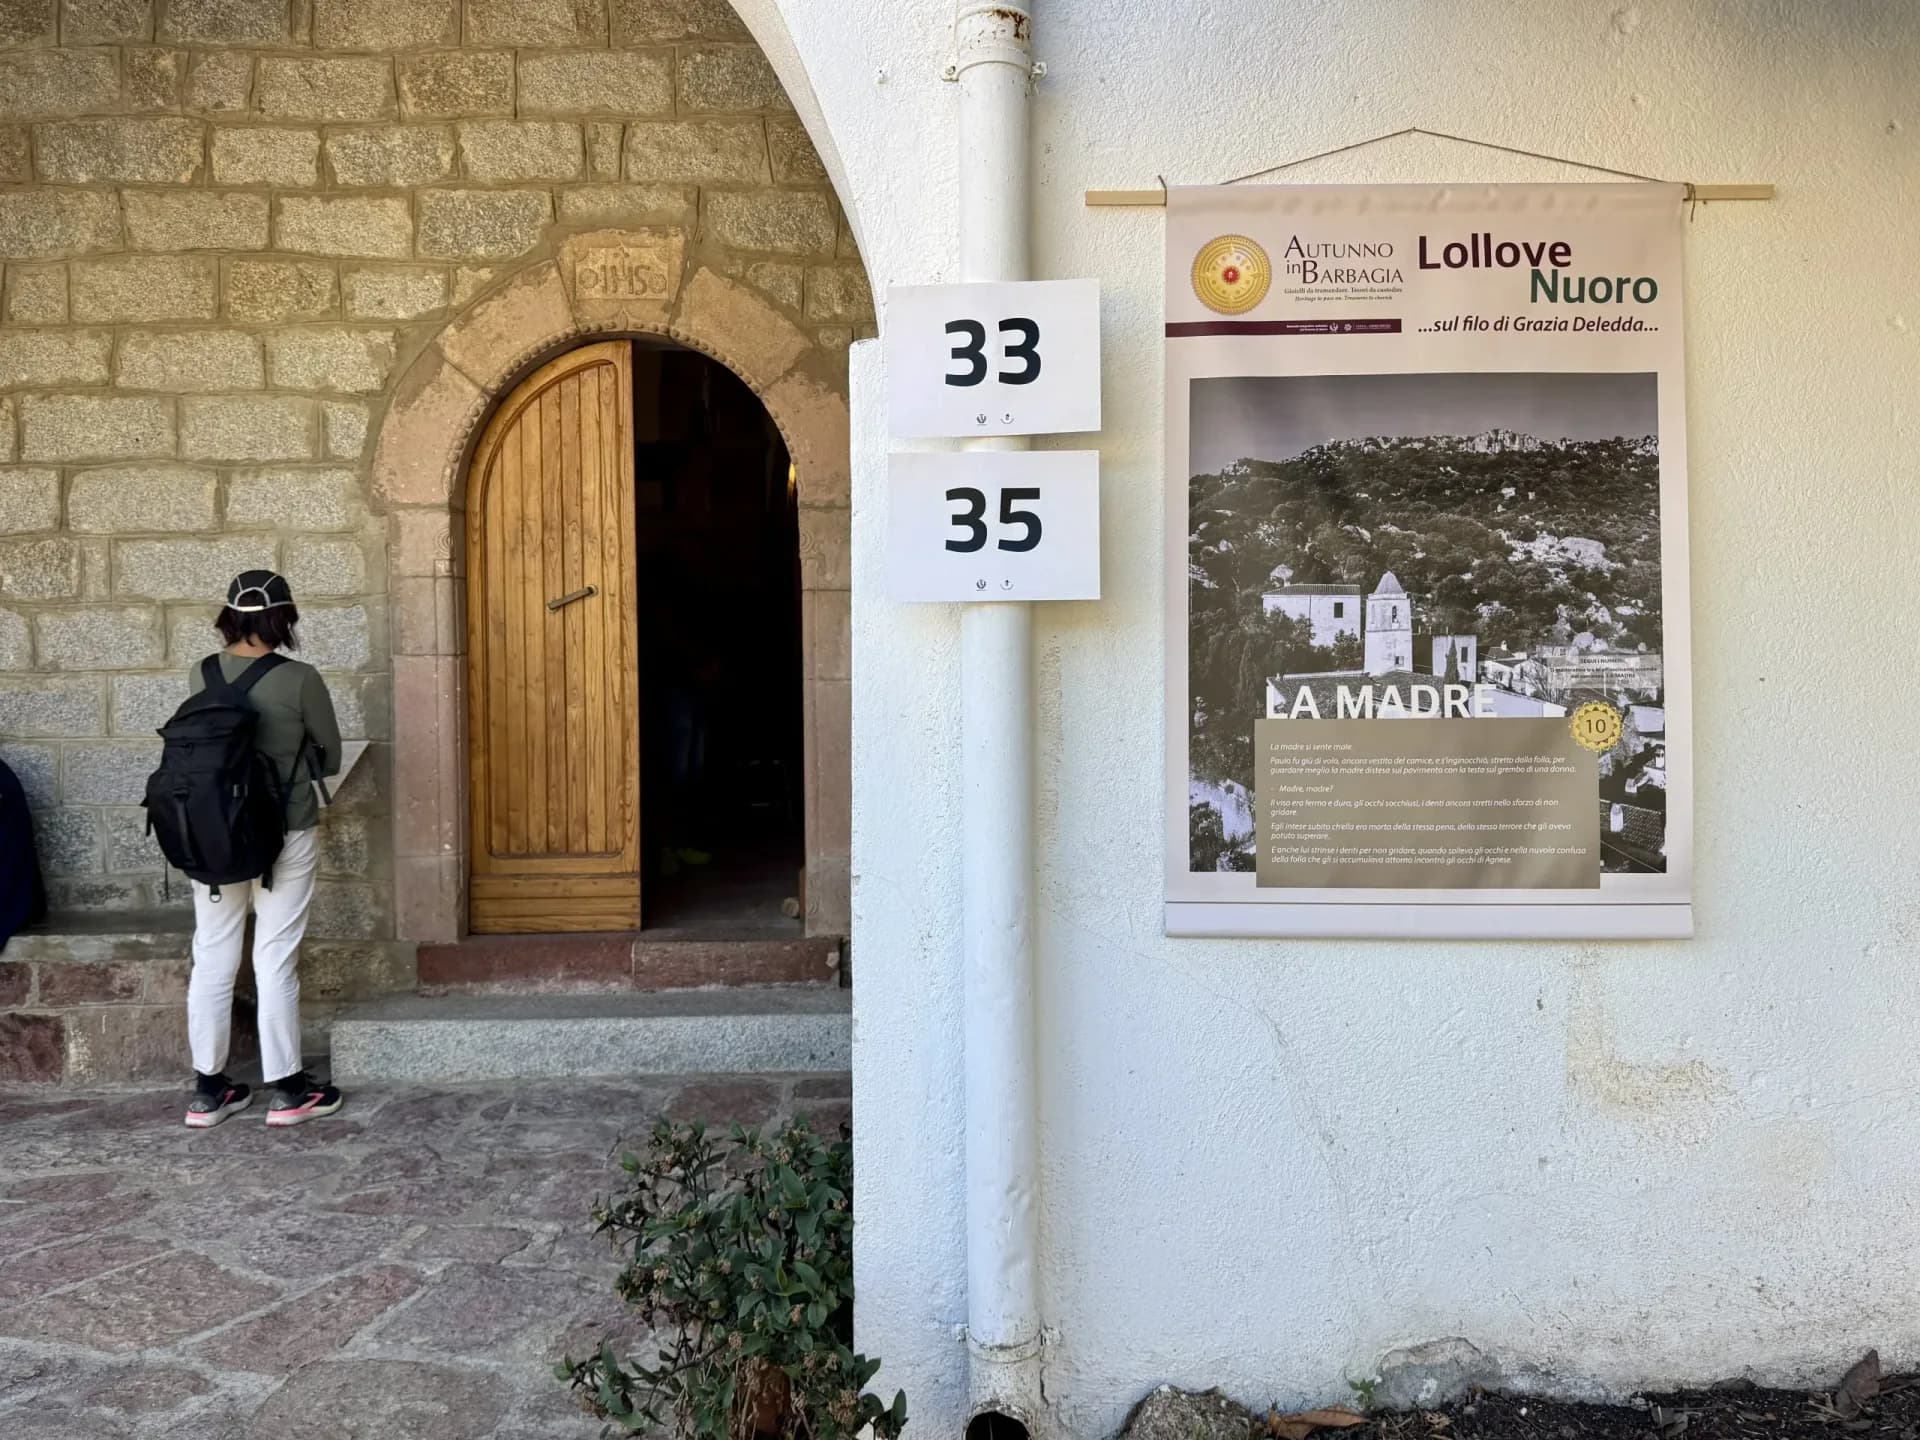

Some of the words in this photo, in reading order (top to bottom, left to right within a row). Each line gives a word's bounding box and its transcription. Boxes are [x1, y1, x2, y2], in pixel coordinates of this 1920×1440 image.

[1418, 233, 1572, 269] Lollove
[1530, 269, 1658, 304] Nuoro
[1418, 316, 1459, 332] ...sul
[1462, 315, 1489, 332] filo
[1493, 316, 1510, 332] di
[1513, 316, 1568, 332] Grazia
[1572, 316, 1659, 332] Deledda...
[945, 317, 1042, 387] 33
[945, 487, 1043, 553] 35
[1266, 684, 1321, 719] LA
[1337, 684, 1498, 719] MADRE
[1585, 719, 1606, 733] 10
[1270, 743, 1279, 751] La
[1280, 743, 1304, 751] madre
[1305, 743, 1311, 751] si
[1313, 743, 1332, 751] sente
